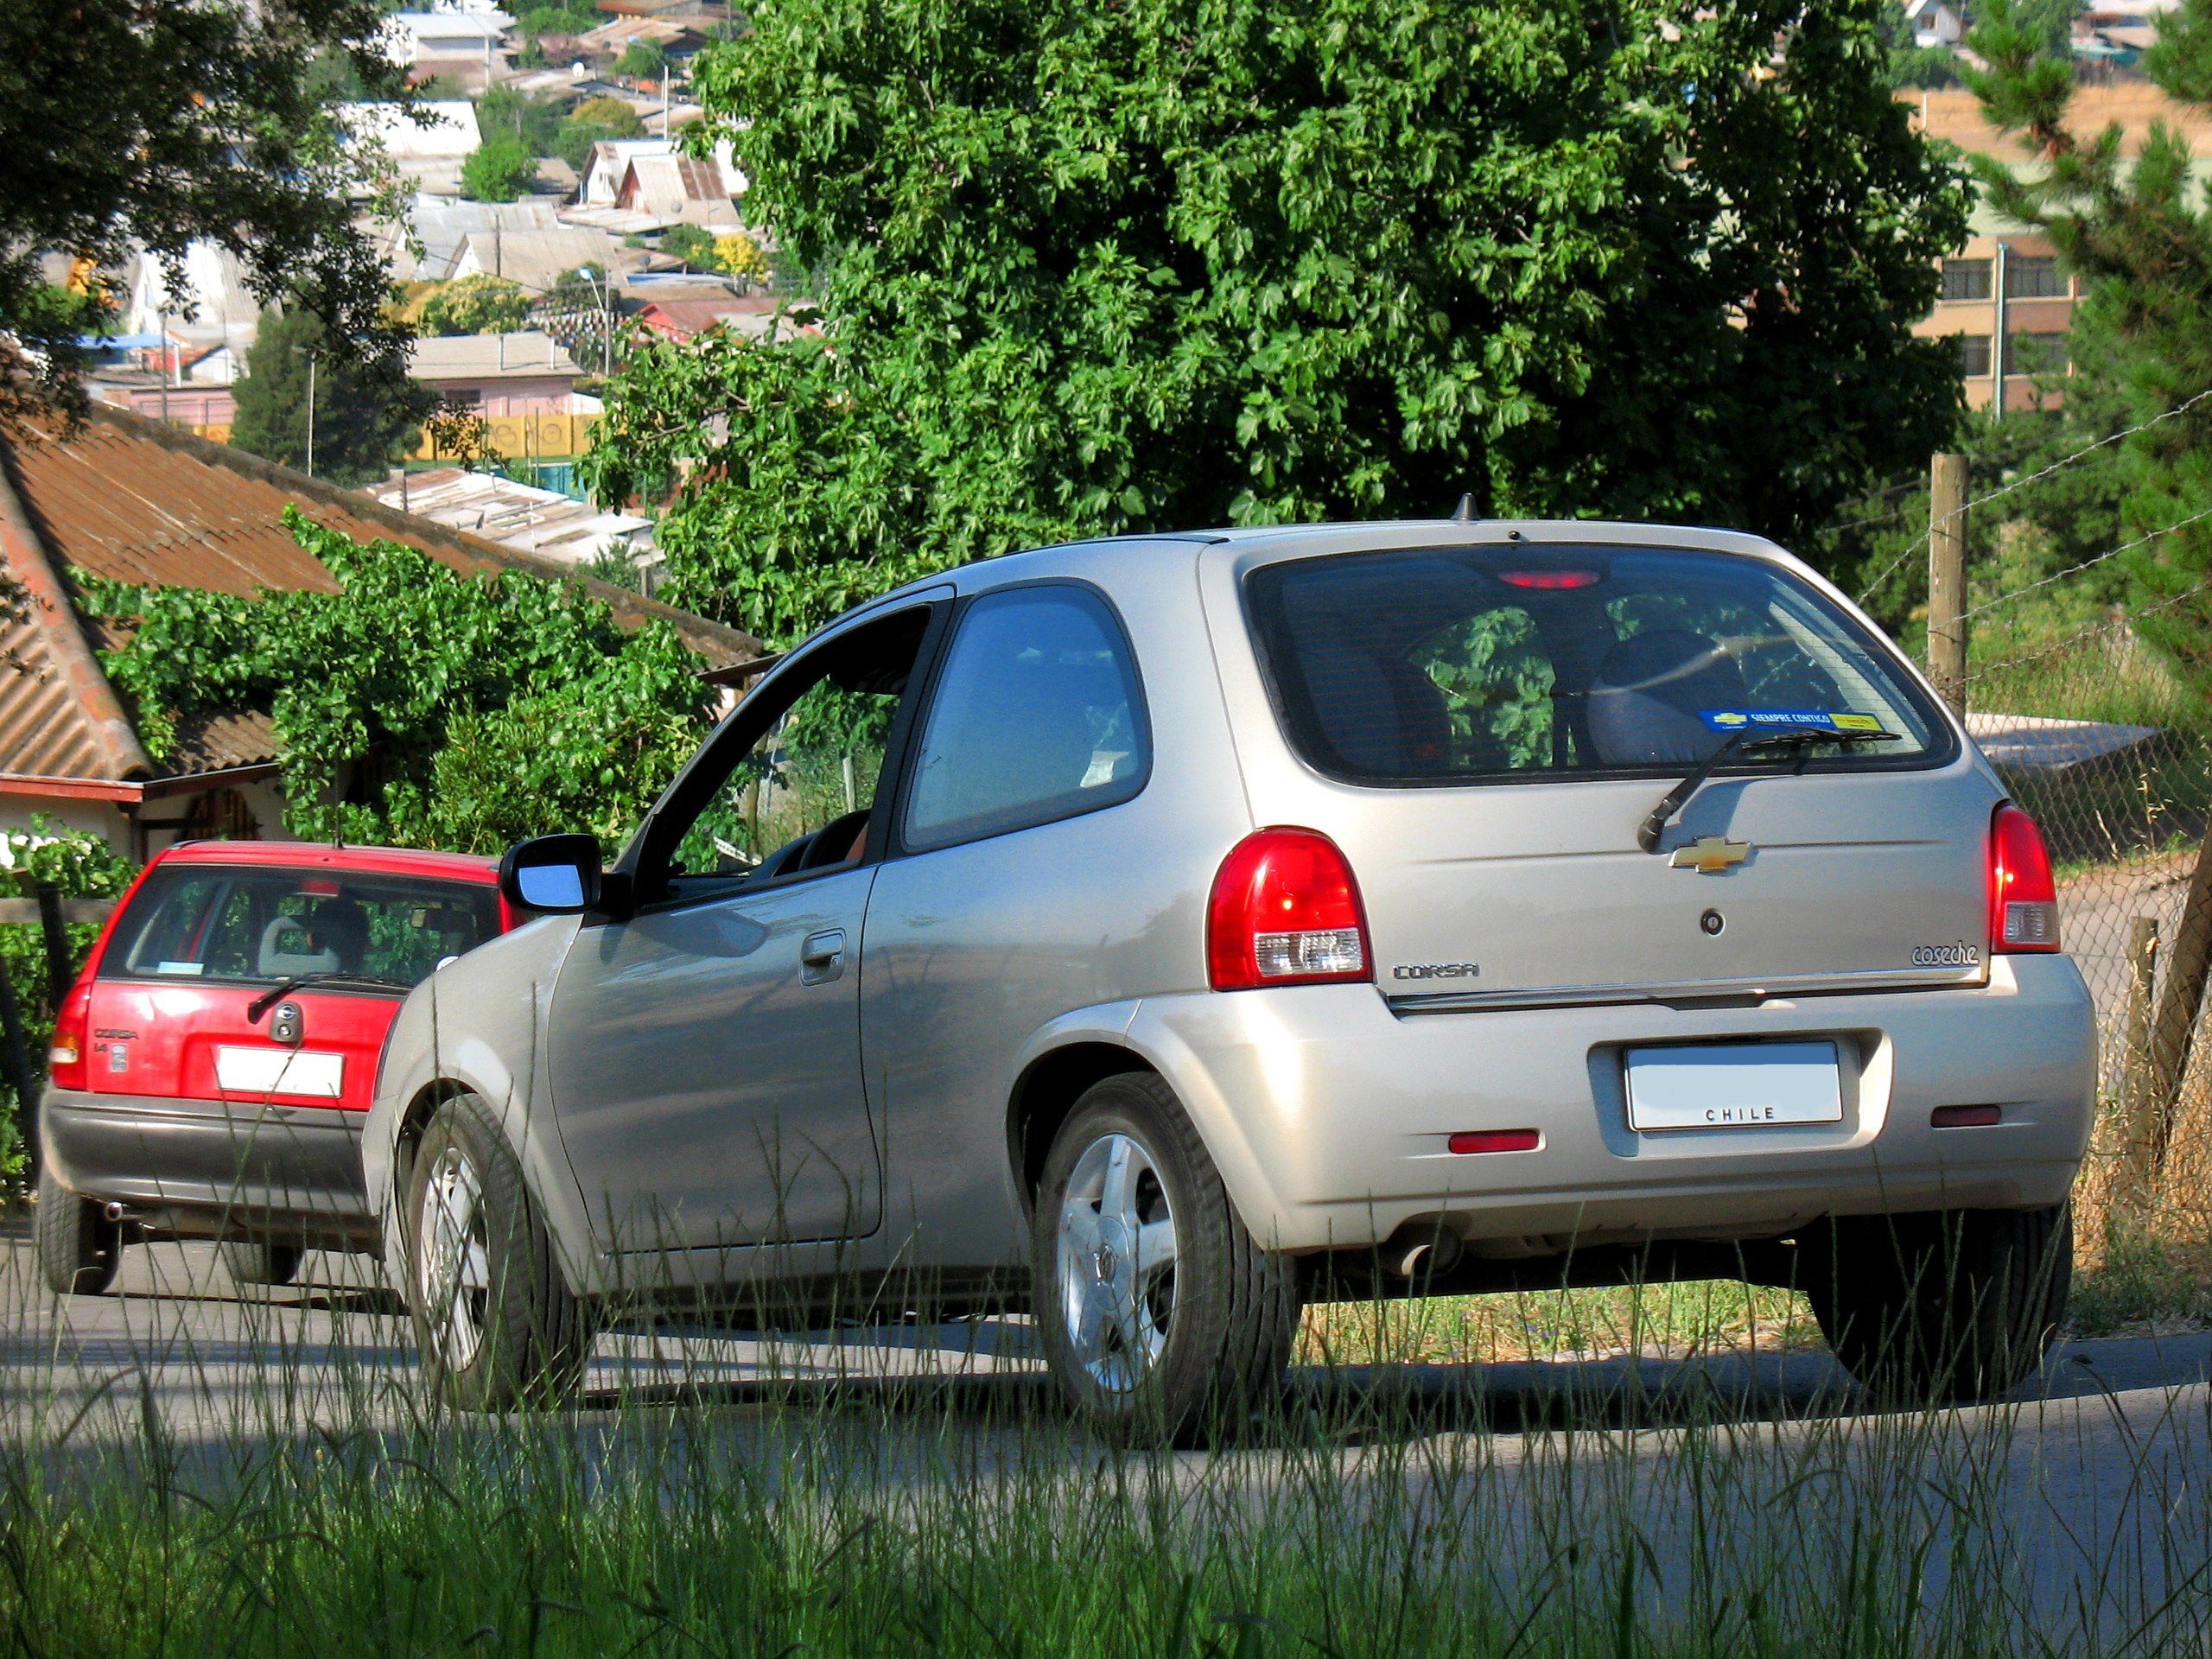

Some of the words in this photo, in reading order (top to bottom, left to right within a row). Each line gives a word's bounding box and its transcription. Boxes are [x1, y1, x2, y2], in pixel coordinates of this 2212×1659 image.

[1751, 714, 1793, 722] SIEMPRE
[1791, 714, 1831, 723] CONTIGO
[1393, 962, 1480, 980] CORSA
[1705, 1107, 1775, 1122] CHILE
